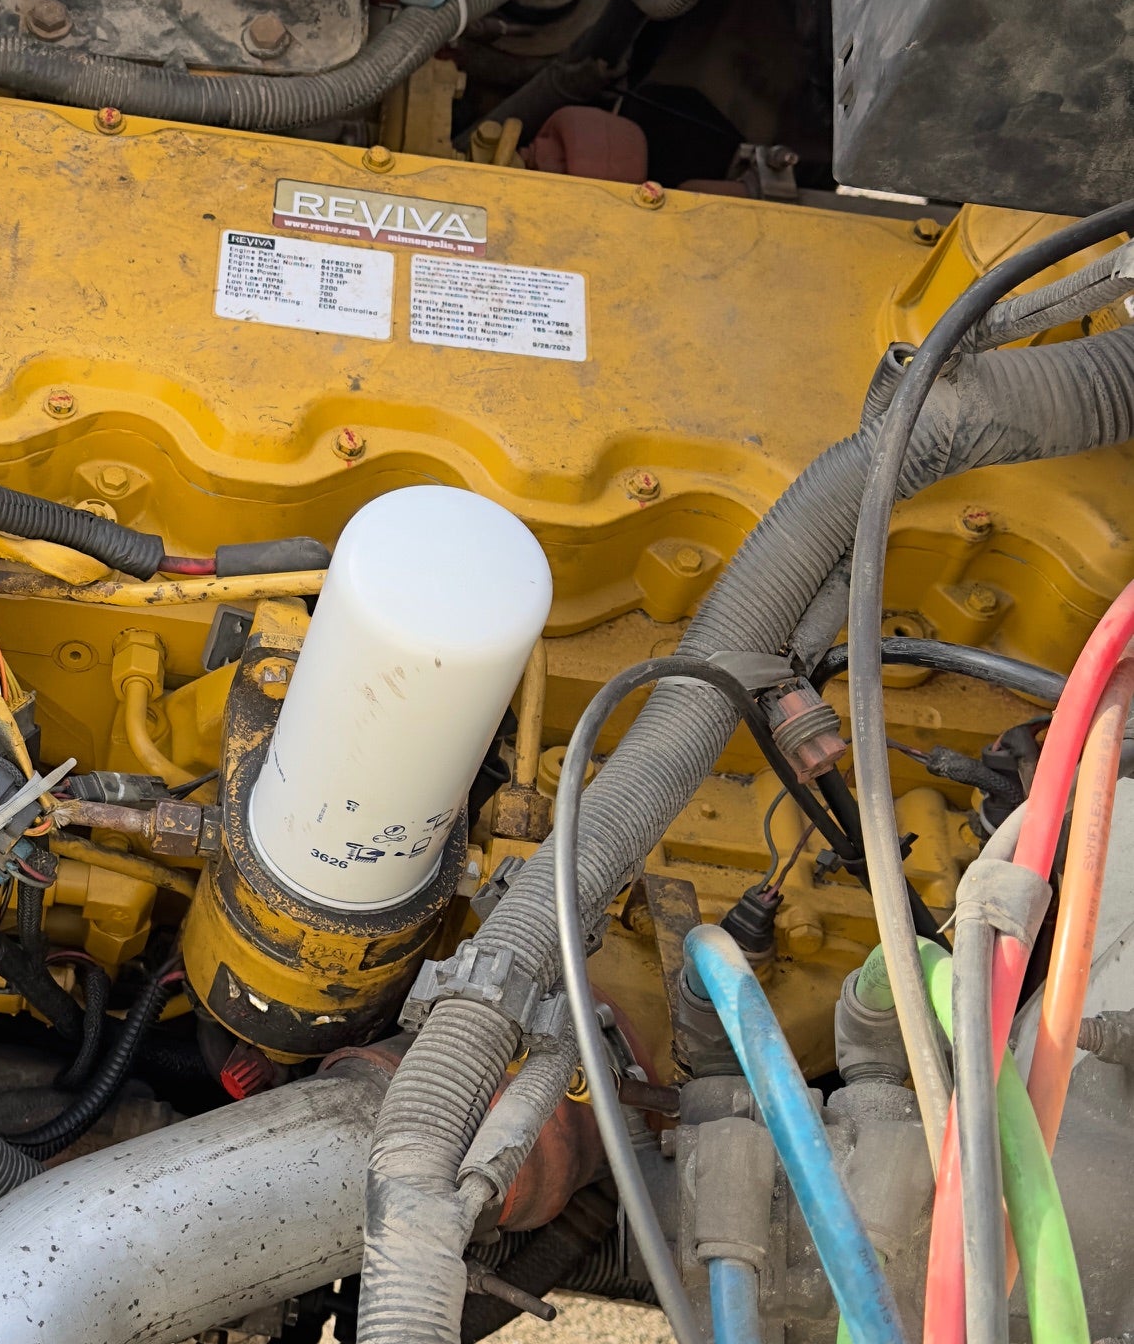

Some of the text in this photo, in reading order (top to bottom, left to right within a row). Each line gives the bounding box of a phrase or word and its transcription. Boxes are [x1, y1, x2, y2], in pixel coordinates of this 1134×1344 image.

[293, 191, 475, 241] REVIVA
[232, 236, 273, 247] REVIVA
[413, 298, 438, 306] Family
[339, 306, 378, 315] Controlled
[309, 848, 349, 870] 3626
